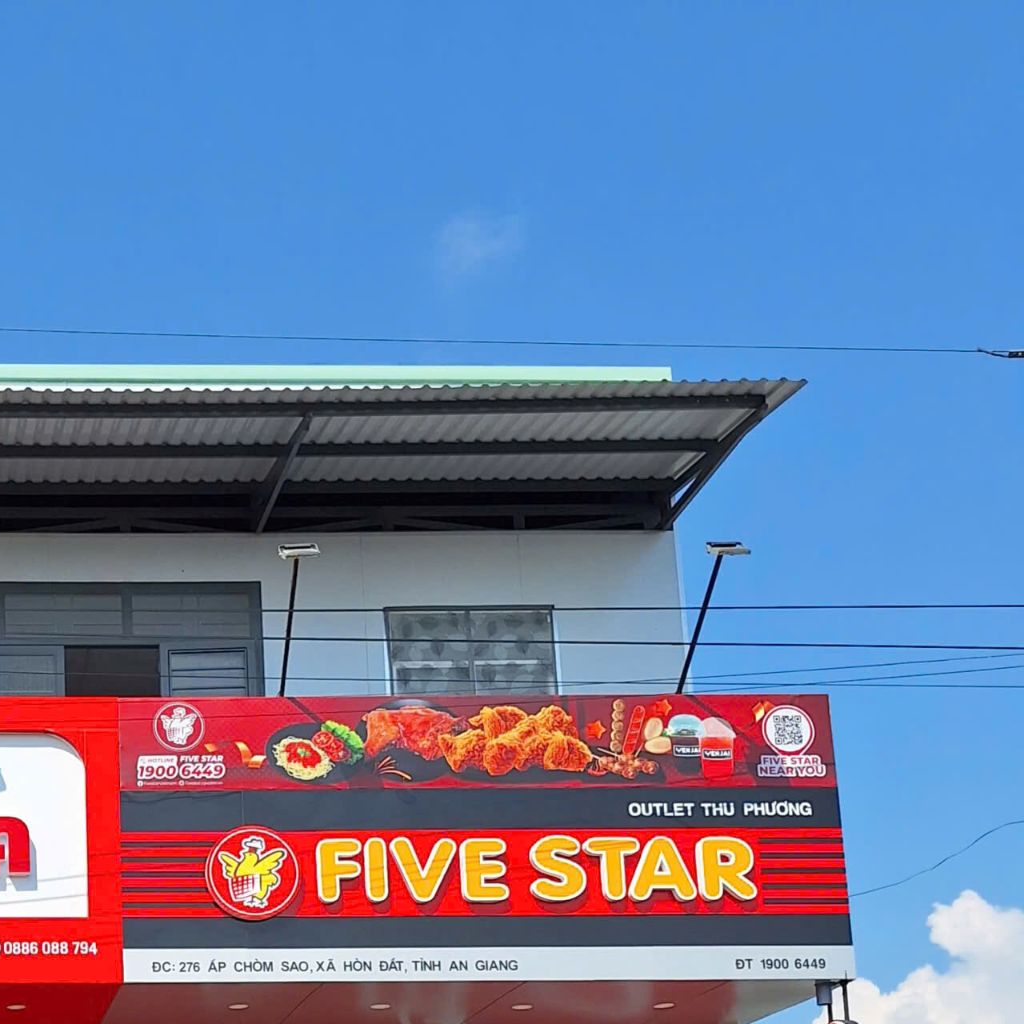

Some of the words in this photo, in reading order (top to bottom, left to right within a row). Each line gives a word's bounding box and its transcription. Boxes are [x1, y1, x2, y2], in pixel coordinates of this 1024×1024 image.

[180, 755, 199, 763] FIVE
[201, 755, 223, 763] STAR
[762, 757, 787, 765] FIVE
[791, 757, 819, 765] STAR
[138, 765, 176, 778] 1900
[180, 764, 224, 778] 6449
[759, 766, 793, 775] NEAR
[797, 766, 824, 775] YOU
[628, 802, 694, 817] OUTLET
[701, 802, 735, 817] THU
[743, 800, 813, 816] PHƯƠNG
[315, 835, 510, 903] FIVE
[529, 835, 758, 903] STAR
[3, 941, 38, 955] 0886
[42, 941, 68, 955] 088
[72, 941, 97, 955] 794
[152, 961, 175, 972] ĐC:
[179, 961, 200, 972] 276
[234, 958, 274, 972] CHÒM
[281, 960, 313, 974] SAO,
[316, 958, 335, 972] XÃ
[343, 957, 372, 971] HÒN
[449, 960, 468, 971] AN
[476, 960, 519, 971] GIANG
[735, 959, 753, 969] ĐT
[761, 958, 789, 969] 1900
[794, 958, 826, 969] 6449
